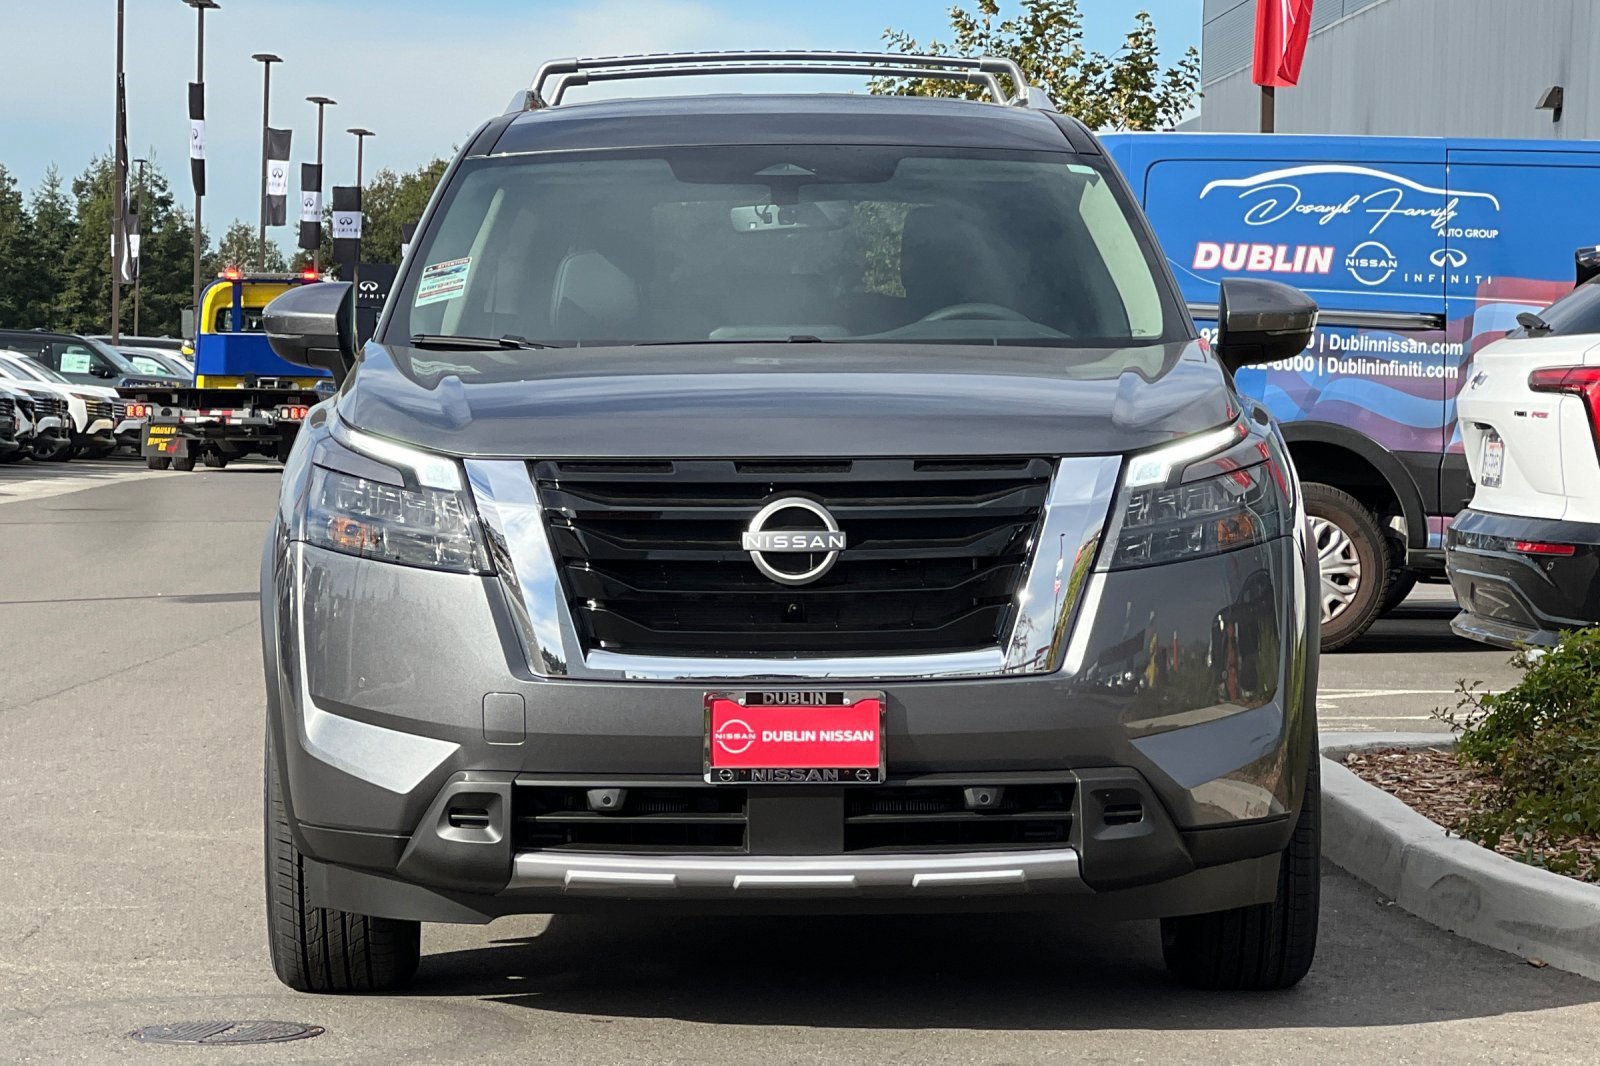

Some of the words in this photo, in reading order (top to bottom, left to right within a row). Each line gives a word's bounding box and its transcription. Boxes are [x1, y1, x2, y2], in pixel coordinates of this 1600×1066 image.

[1363, 188, 1459, 234] Family
[1437, 228, 1463, 238] AUTO
[1464, 229, 1499, 239] GROUP
[1192, 241, 1335, 274] DUBLIN
[1345, 258, 1398, 268] NISSAN
[1404, 273, 1492, 285] INFINITI
[1329, 334, 1464, 356] Dublinnissan.com
[1327, 356, 1459, 379] Dublininfiniti.com
[746, 535, 844, 548] NISSAN
[762, 692, 827, 705] DUBLIN
[762, 731, 817, 742] DUBLIN
[819, 731, 874, 742] NISSAN
[750, 768, 839, 782] NISSAN
